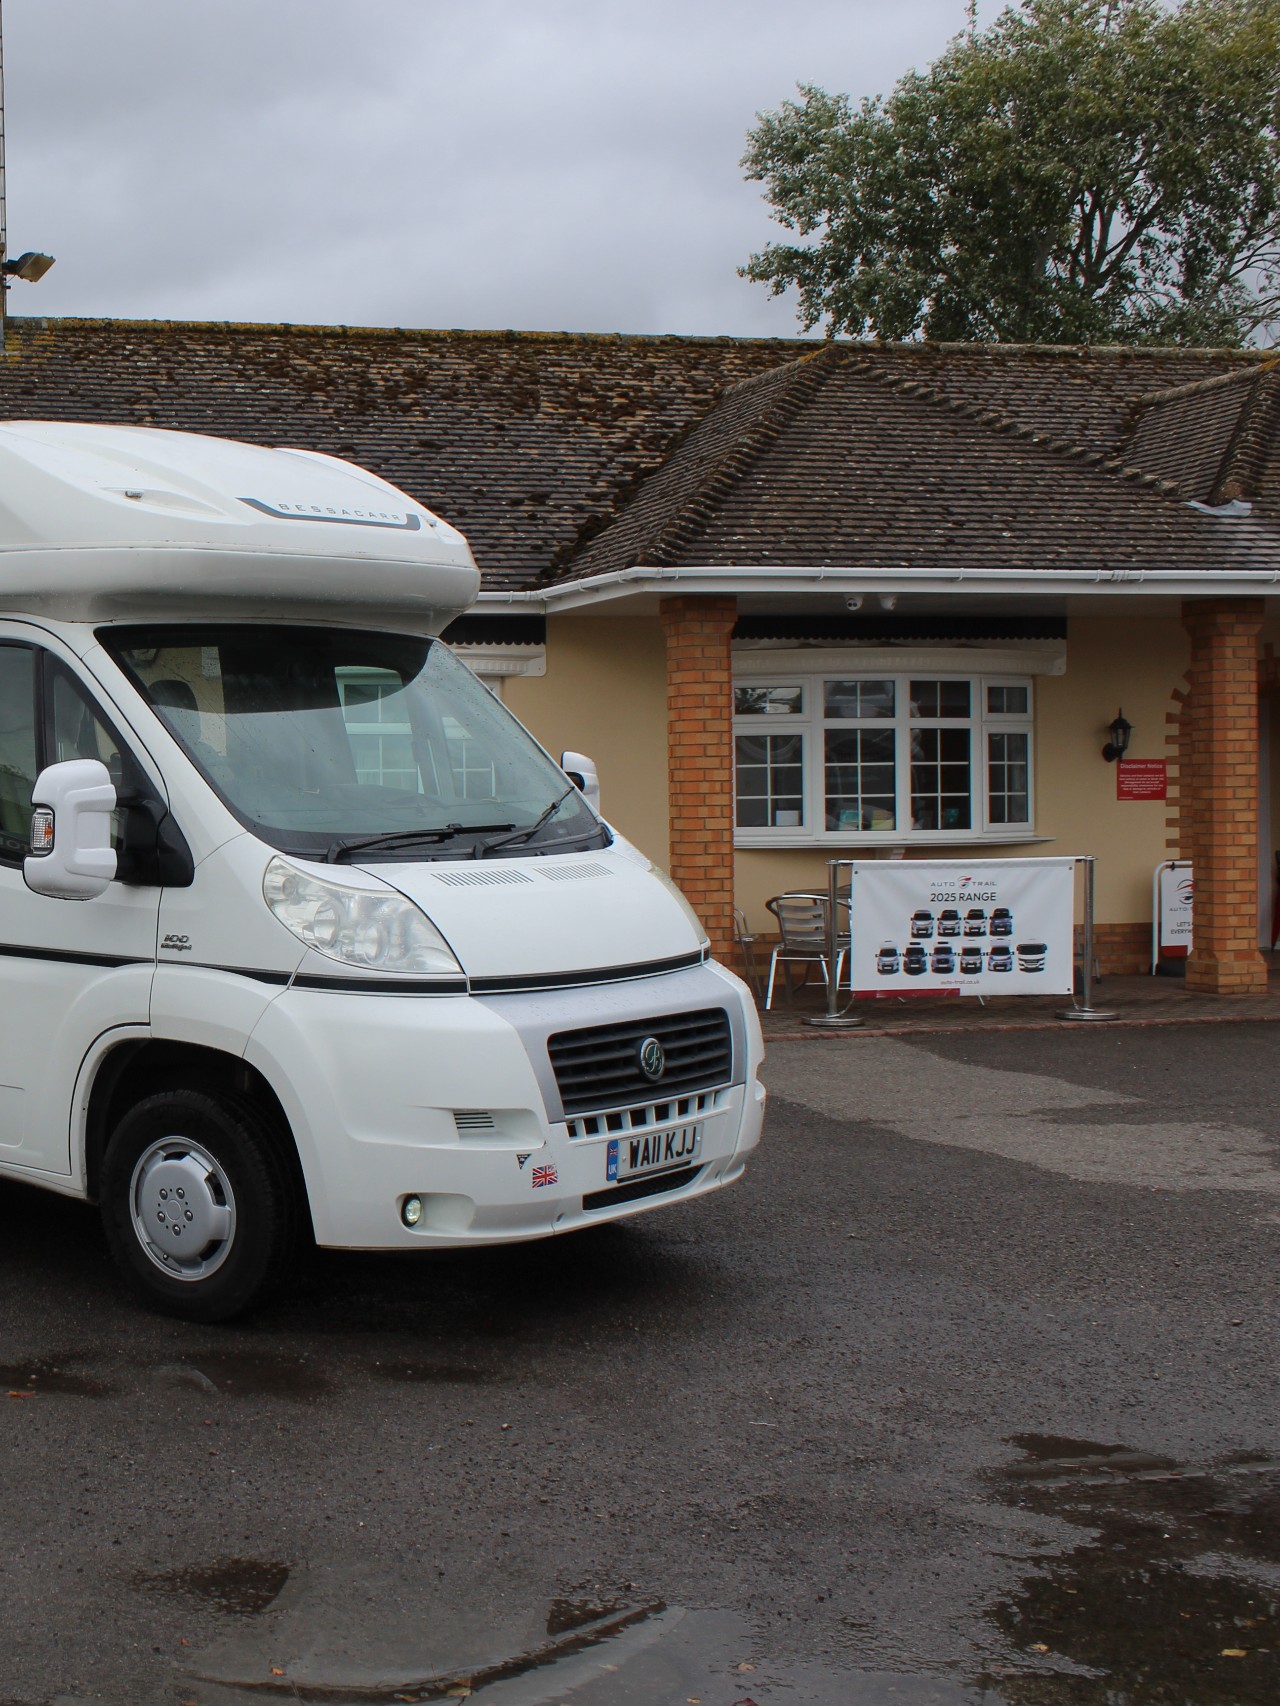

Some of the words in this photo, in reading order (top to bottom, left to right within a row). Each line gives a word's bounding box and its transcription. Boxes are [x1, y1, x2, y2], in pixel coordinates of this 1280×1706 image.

[278, 503, 401, 520] BESSACARR
[930, 892, 957, 902] 2025
[959, 892, 997, 902] RANGE
[664, 1126, 697, 1161] KJJ
[608, 1163, 617, 1175] UK
